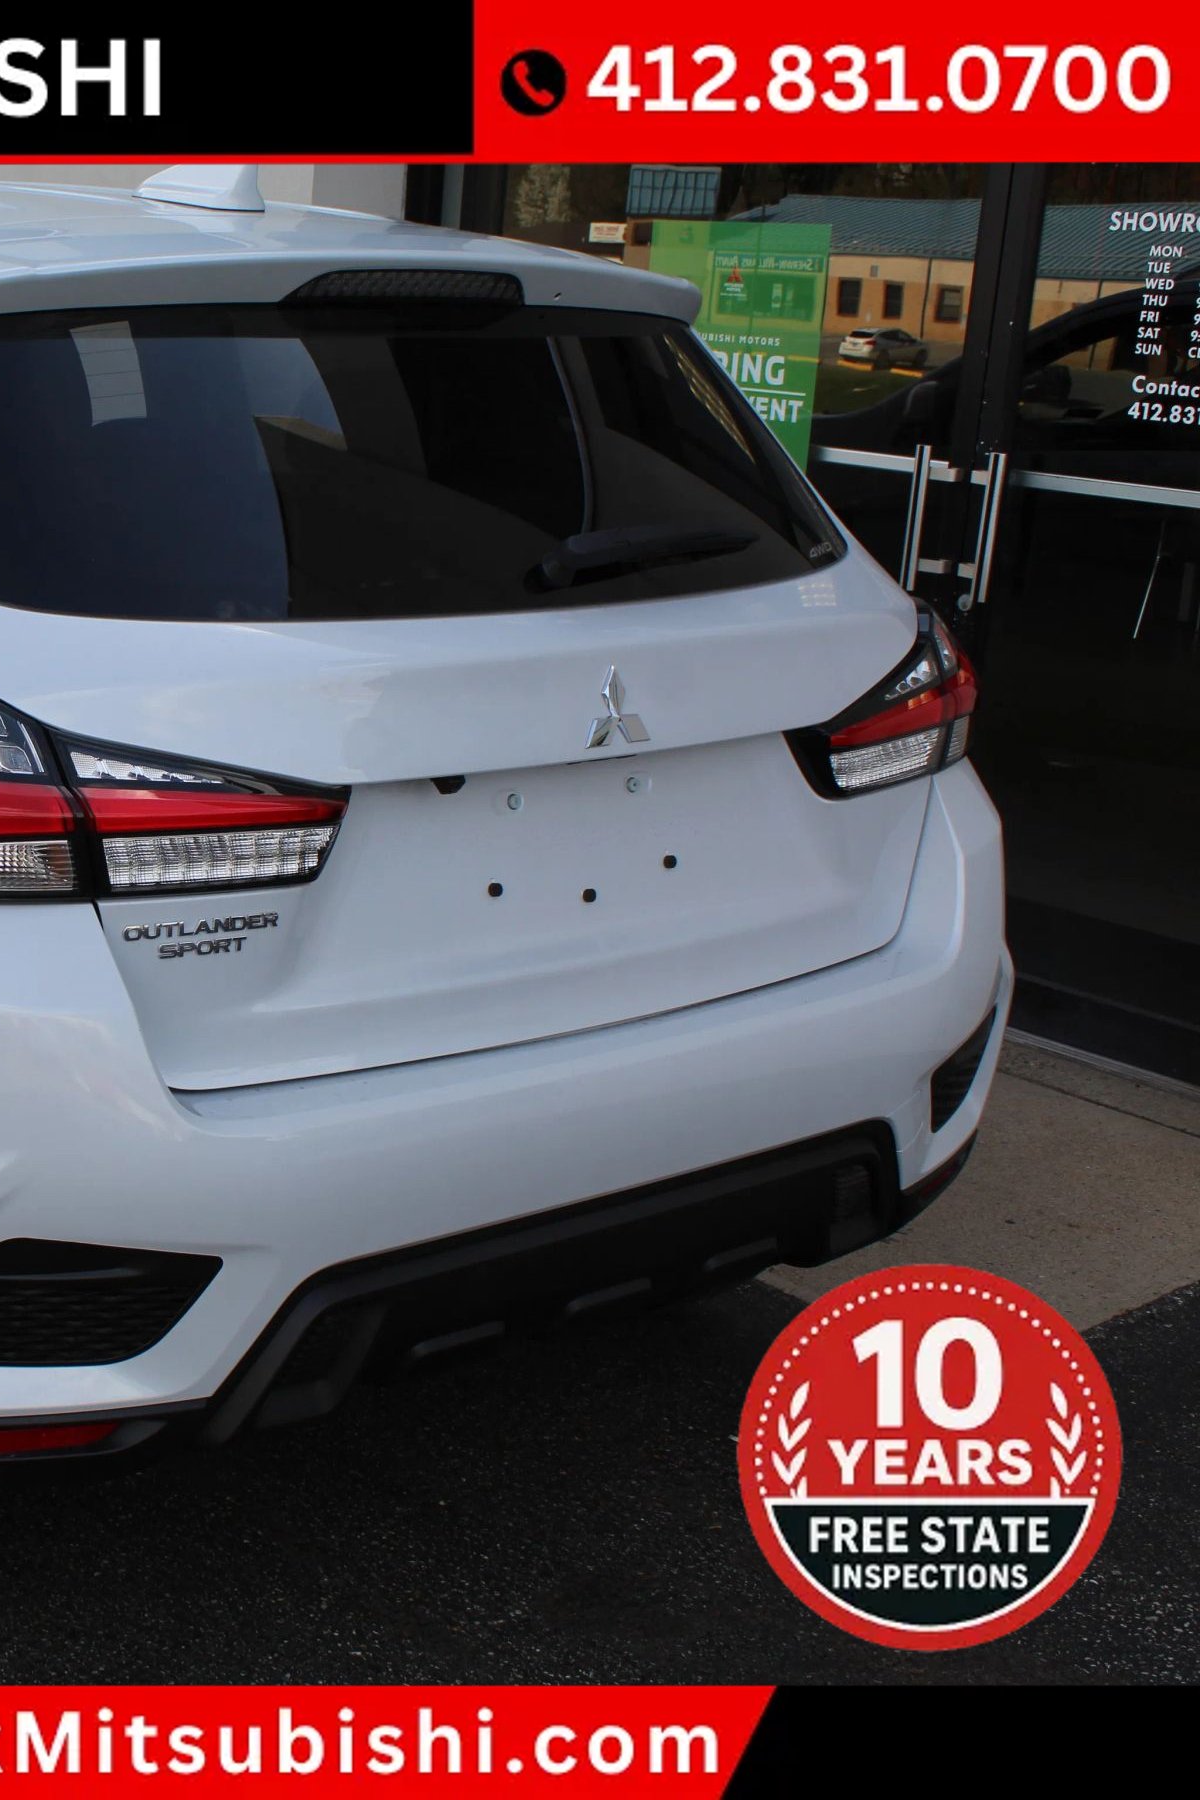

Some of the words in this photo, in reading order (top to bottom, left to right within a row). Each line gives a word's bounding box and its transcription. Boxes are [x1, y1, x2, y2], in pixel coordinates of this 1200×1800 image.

[1108, 211, 1200, 232] SHOWR
[1149, 245, 1183, 257] MON
[1147, 261, 1171, 274] TUE
[1145, 278, 1175, 290] WED
[1142, 294, 1169, 306] THU
[1140, 310, 1160, 322] FRI
[1137, 327, 1161, 339] SAT
[698, 332, 735, 343] UBISHI
[738, 335, 781, 347] MOTORS
[1134, 343, 1162, 355] SUN
[123, 911, 279, 942] OUTLANDER
[158, 936, 248, 959] SPORT
